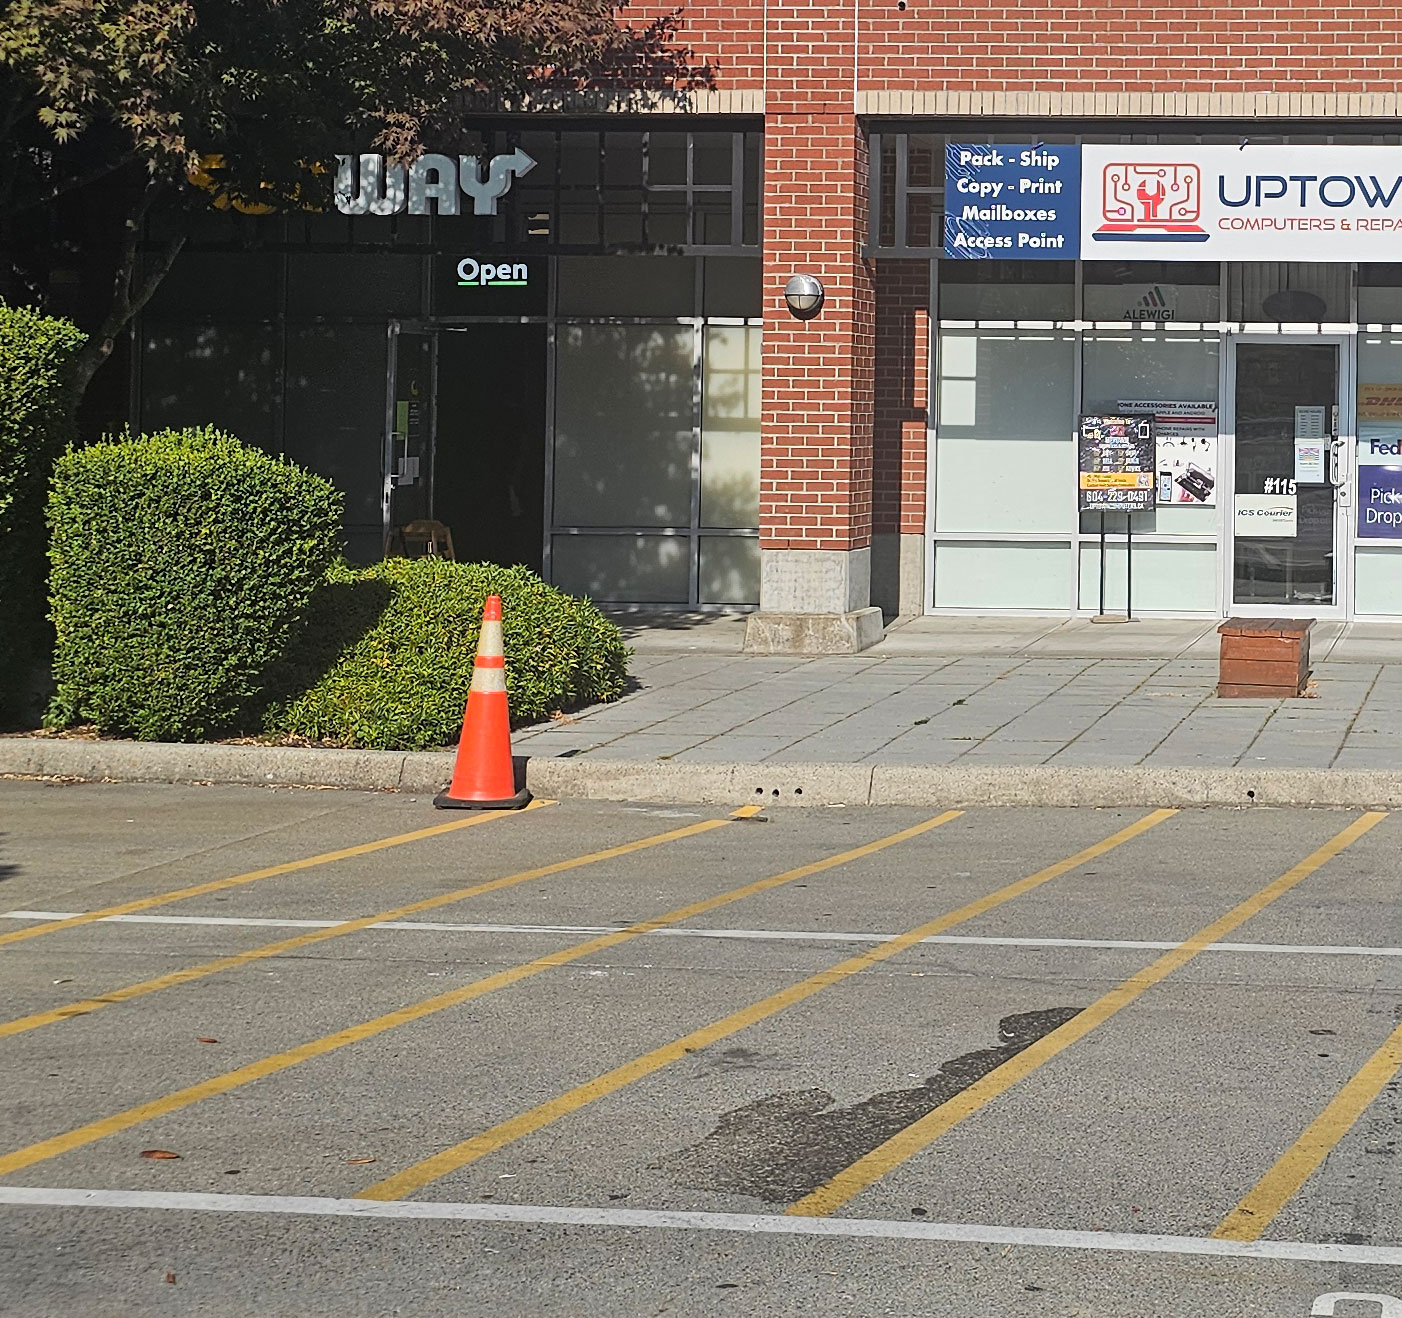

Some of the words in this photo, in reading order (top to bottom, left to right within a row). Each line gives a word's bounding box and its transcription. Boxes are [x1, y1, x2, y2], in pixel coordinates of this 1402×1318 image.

[960, 150, 1004, 166] Pack
[1019, 151, 1060, 171] Ship
[956, 178, 1004, 198] Copy
[1019, 178, 1063, 194] Print
[962, 204, 1057, 221] Mailboxes
[1218, 217, 1336, 231] COMPUTERS
[1340, 218, 1352, 231] &
[953, 232, 1013, 248] Access
[1018, 232, 1065, 248] Point
[457, 258, 528, 286] Open
[1123, 309, 1175, 320] ALEWIGI
[1264, 477, 1297, 495] #115
[1370, 487, 1401, 504] Pick
[1237, 509, 1255, 517] ICS
[1256, 509, 1293, 517] Courier
[1366, 507, 1402, 528] Drop
